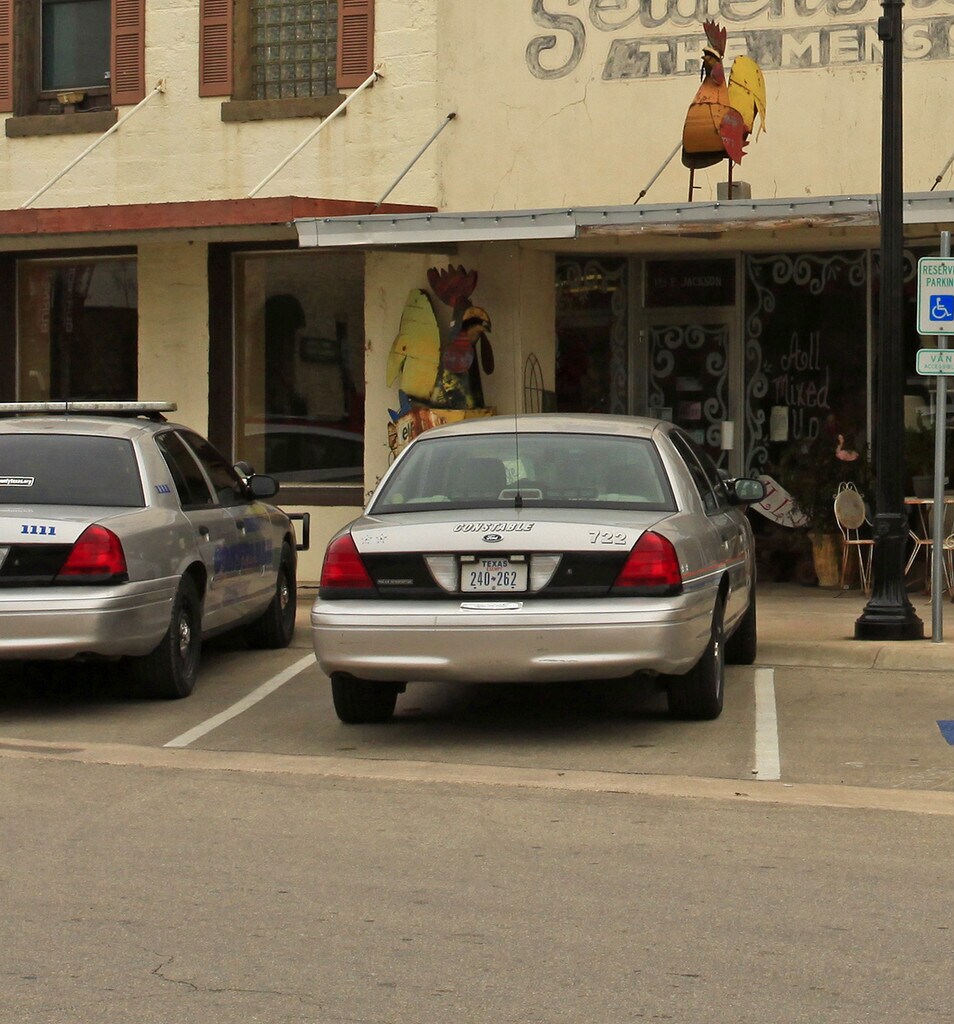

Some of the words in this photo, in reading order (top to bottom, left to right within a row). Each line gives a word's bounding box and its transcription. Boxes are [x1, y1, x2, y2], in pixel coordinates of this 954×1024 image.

[639, 38, 748, 74] THE
[681, 275, 722, 287] JACKSON
[930, 355, 952, 363] VAN
[772, 366, 830, 410] Mixed
[21, 524, 57, 536] 1111
[453, 523, 535, 532] CONSTABLE
[588, 530, 627, 546] 722
